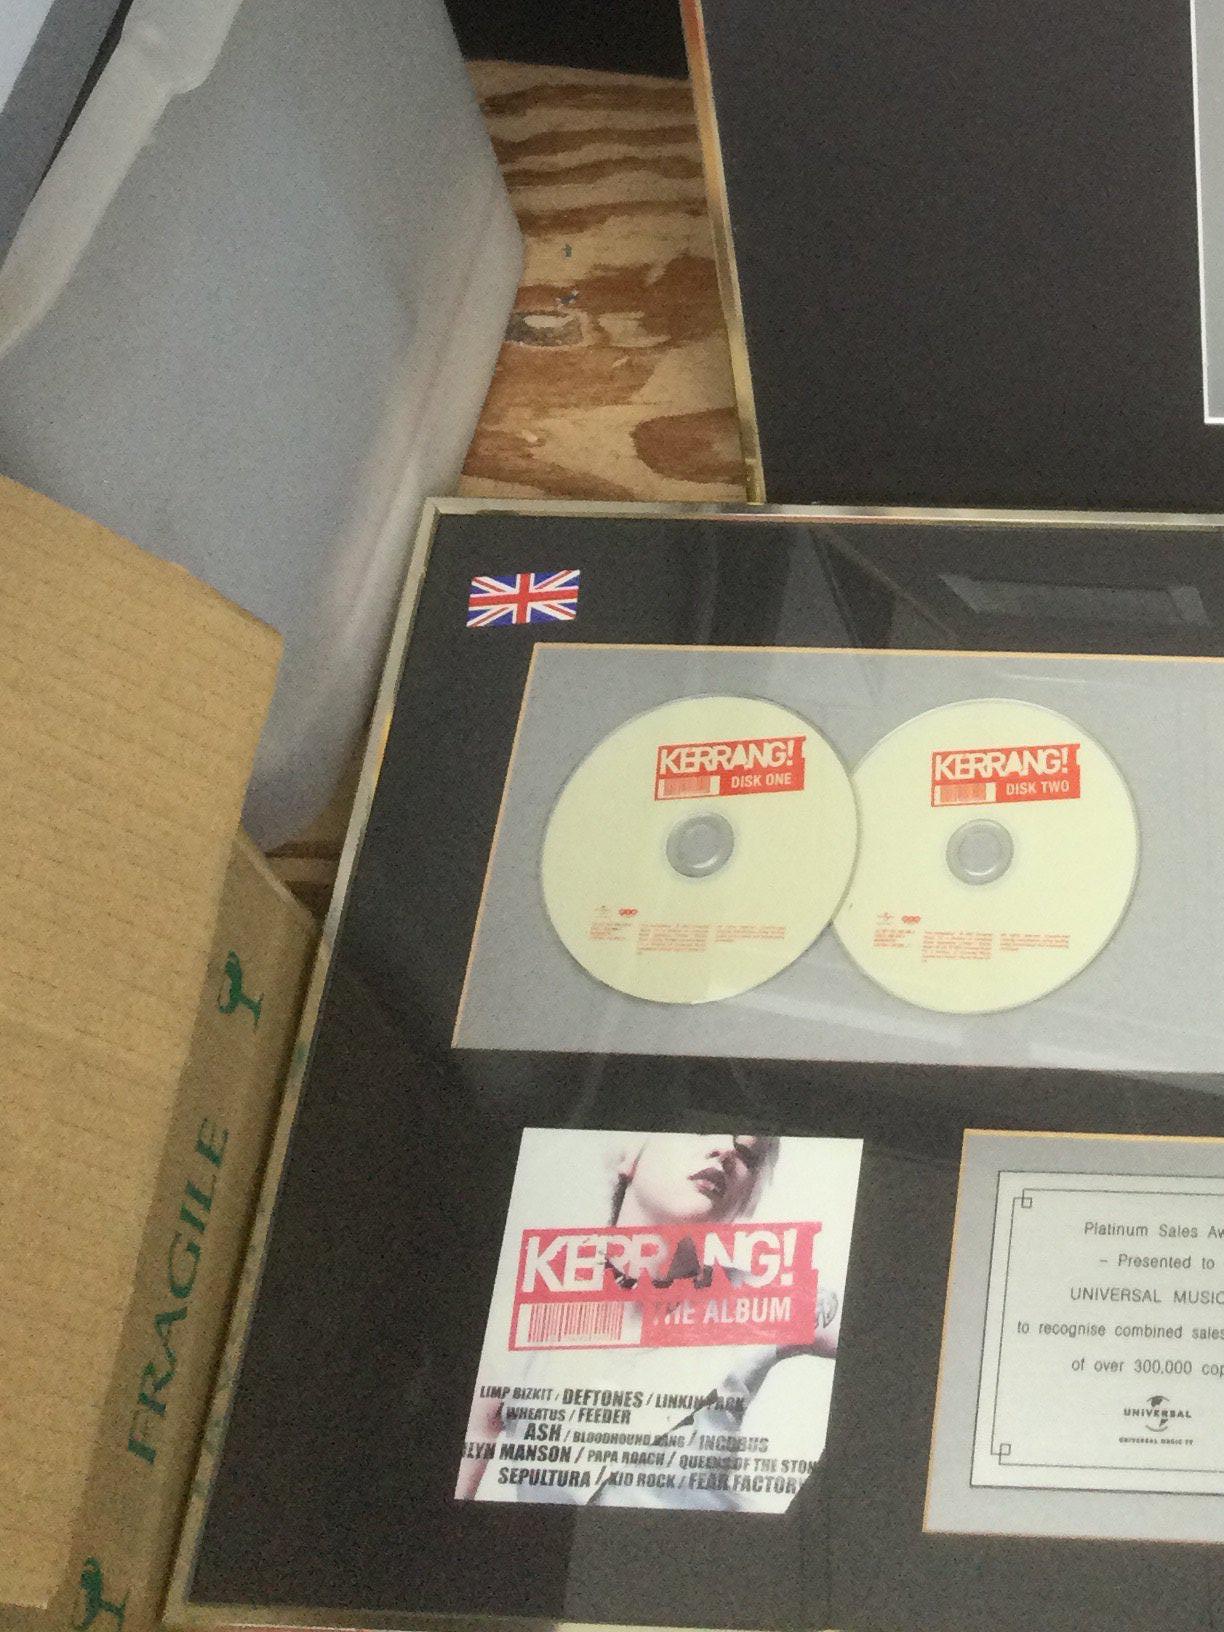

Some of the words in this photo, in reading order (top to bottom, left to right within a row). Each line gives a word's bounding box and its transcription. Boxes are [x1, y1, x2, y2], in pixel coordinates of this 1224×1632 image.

[659, 742, 794, 774] KERRANG!
[934, 748, 1069, 781] KERRANG!
[731, 775, 761, 788] DISK
[765, 773, 792, 787] ONE
[1006, 781, 1037, 796] DISK
[1041, 780, 1070, 794] TWO
[1084, 1221, 1149, 1238] Platinum
[1158, 1223, 1199, 1239] Sales
[522, 1228, 797, 1293] KERRANG!
[1118, 1253, 1192, 1270] Presented
[1201, 1256, 1216, 1270] to
[127, 1118, 229, 1465] FRAGILE
[1070, 1287, 1162, 1304] UNIVERSAL
[703, 1296, 792, 1325] ALBUM
[1017, 1320, 1030, 1335] to
[1038, 1322, 1106, 1338] recognise
[1114, 1323, 1183, 1339] combined
[1071, 1357, 1086, 1372] of
[1094, 1360, 1124, 1373] over
[480, 1385, 510, 1400] LIMP
[512, 1386, 554, 1402] BIZKIT
[562, 1387, 643, 1408] DEFTONES
[506, 1407, 566, 1421] WHEATUS
[578, 1407, 632, 1425] FEEDER
[1123, 1408, 1192, 1419] UNIVERSAL
[523, 1423, 563, 1443] ASH
[572, 1431, 651, 1446] BLOODHOUND
[699, 1434, 769, 1453] INCUBUS
[499, 1443, 572, 1464] MANSON
[587, 1449, 618, 1464] PAPA
[621, 1450, 666, 1466] ROACH
[754, 1458, 778, 1473] THE
[498, 1466, 592, 1488] SEPULTURA
[609, 1471, 634, 1487] KID
[636, 1473, 676, 1489] ROCK
[688, 1473, 730, 1491] FEAR
